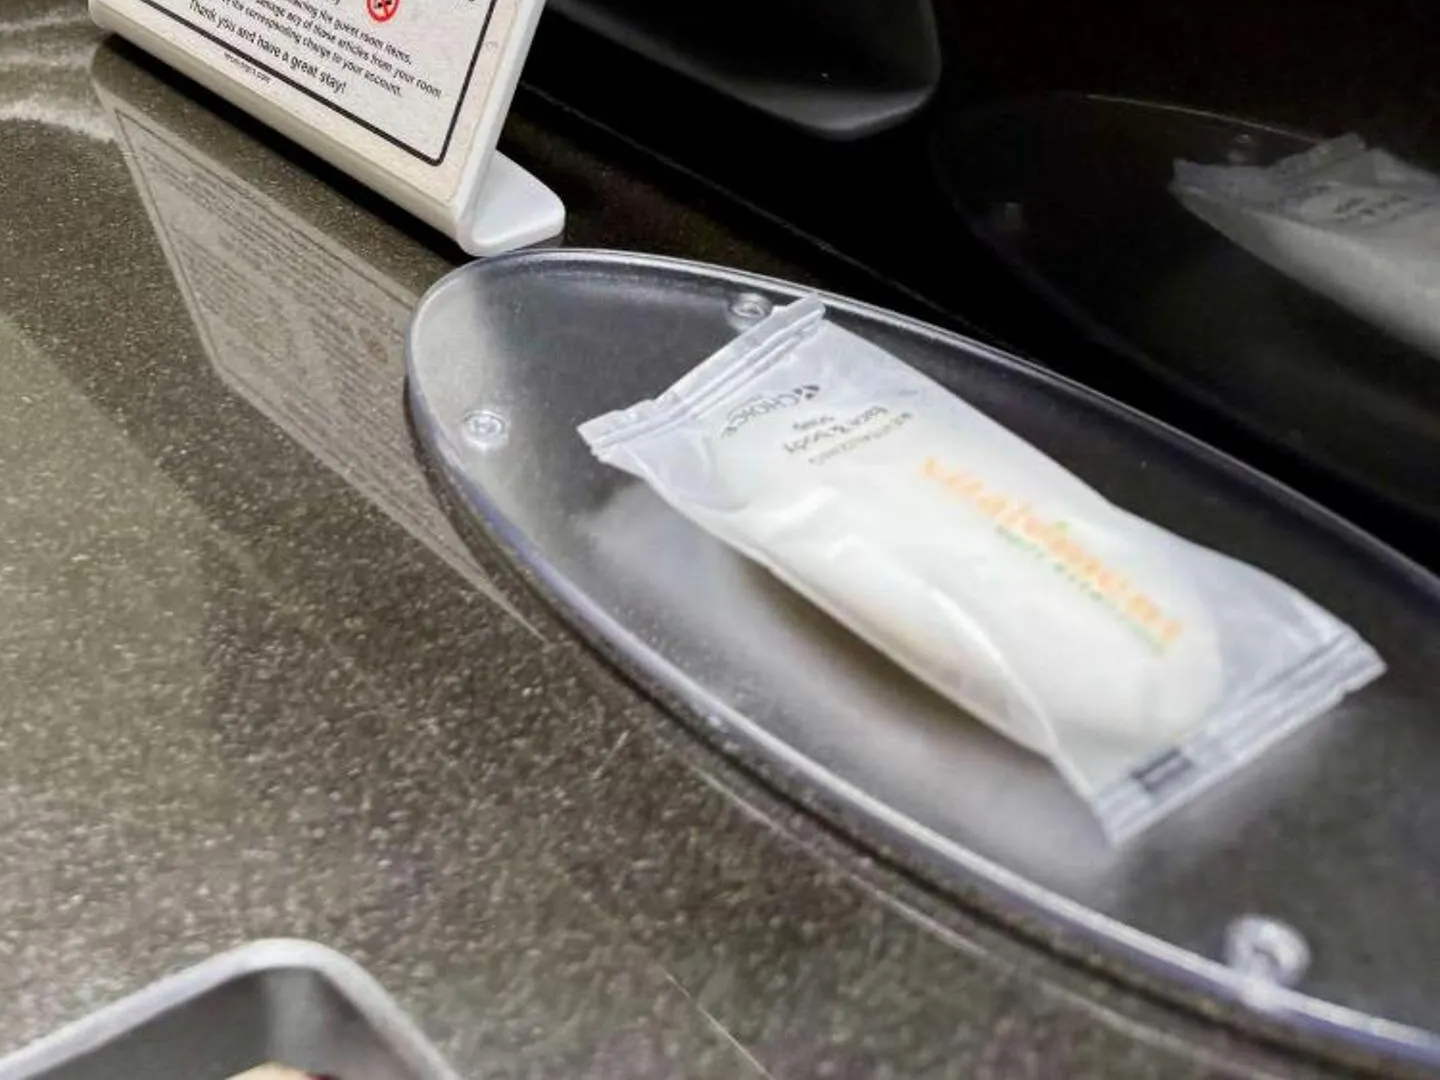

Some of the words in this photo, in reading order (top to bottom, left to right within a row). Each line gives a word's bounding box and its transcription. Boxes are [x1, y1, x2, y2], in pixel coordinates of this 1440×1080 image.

[217, 17, 236, 32] you
[237, 27, 256, 43] and
[257, 35, 281, 57] have
[282, 52, 289, 62] a
[290, 56, 318, 77] great
[393, 69, 415, 83] your
